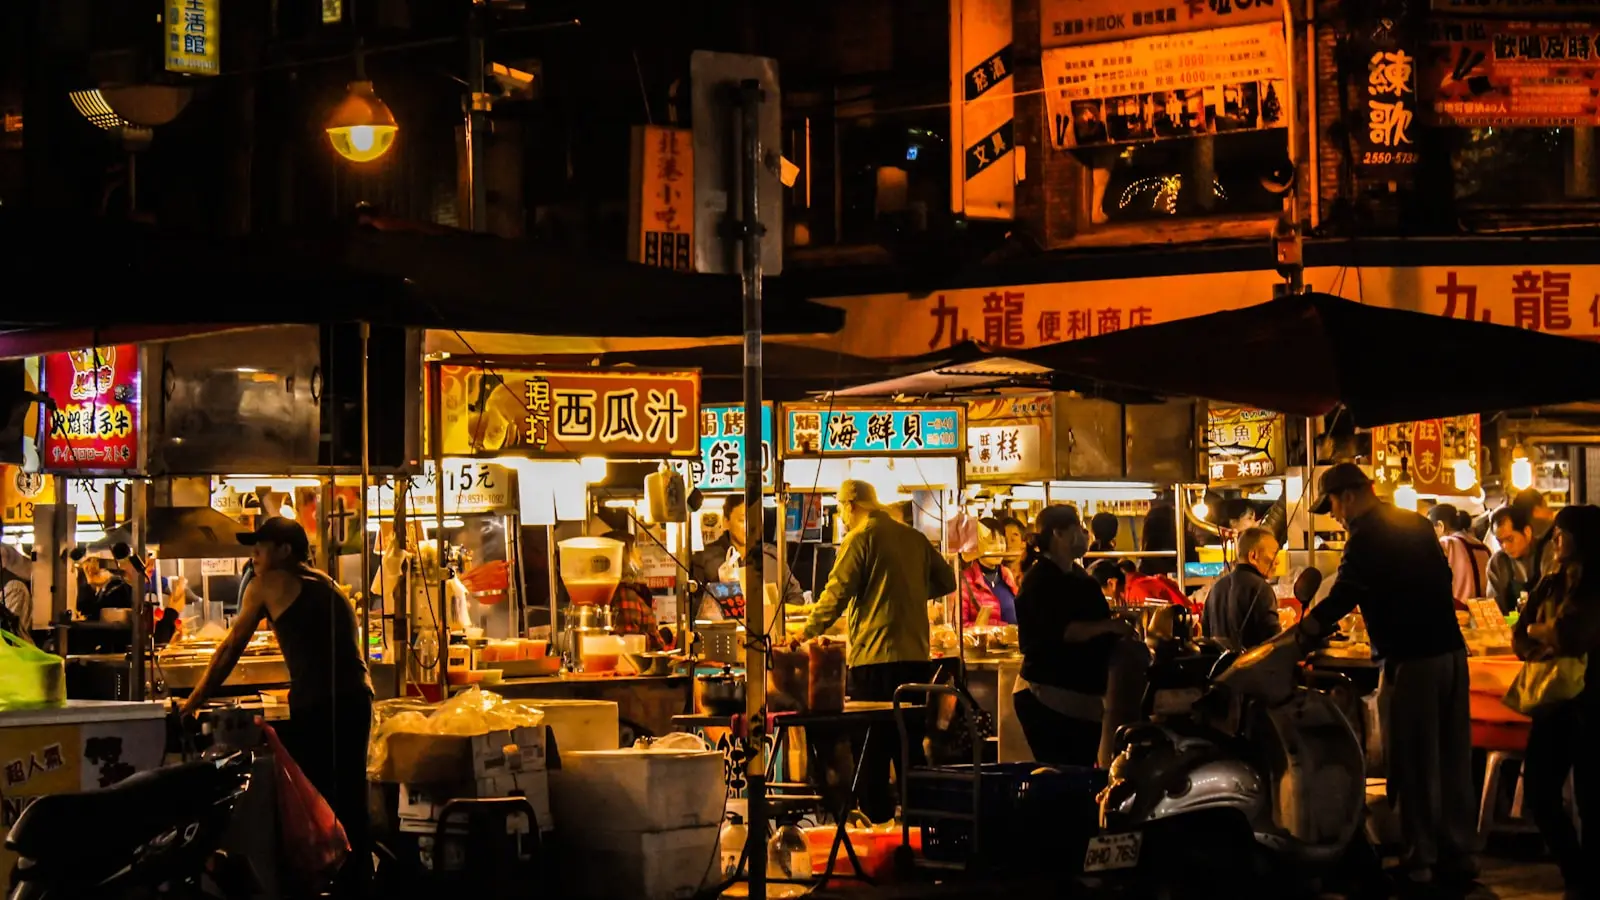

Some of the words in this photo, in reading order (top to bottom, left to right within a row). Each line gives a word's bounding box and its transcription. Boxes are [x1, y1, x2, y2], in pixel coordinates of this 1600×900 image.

[1368, 49, 1414, 147] 練歌
[972, 132, 1006, 168] 文具
[655, 130, 684, 231] 北港小吃
[928, 291, 1025, 350] 九龍
[1037, 306, 1153, 342] 便利商店
[1436, 270, 1571, 330] 九龍
[525, 379, 550, 445] 現打
[555, 389, 686, 442] 西瓜汁
[829, 412, 924, 449] 海鮮貝
[996, 429, 1022, 461] 糕
[1419, 422, 1438, 475] 旺來
[5, 744, 64, 786] 超人氣
